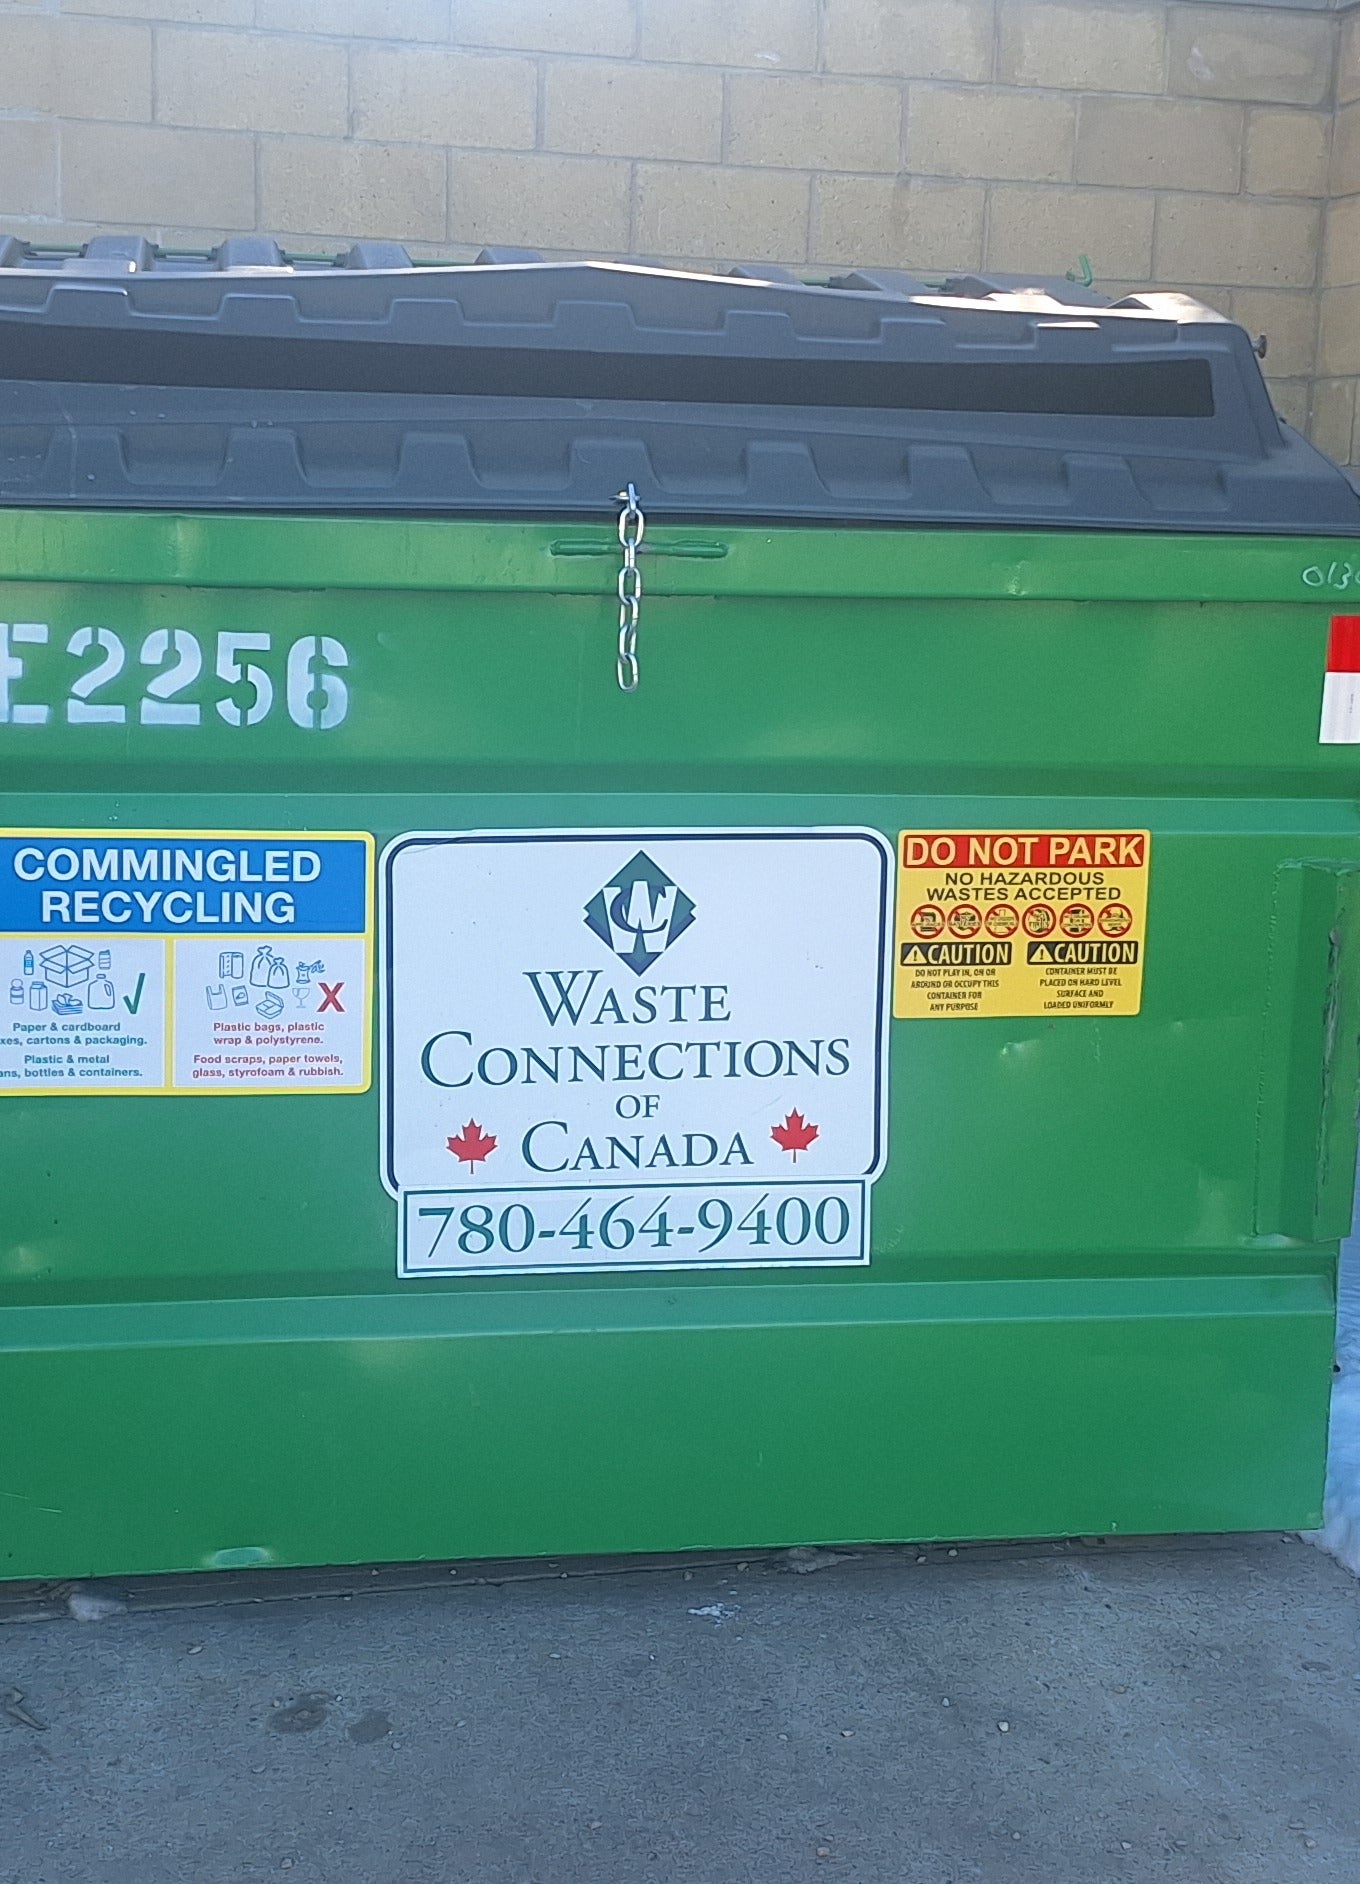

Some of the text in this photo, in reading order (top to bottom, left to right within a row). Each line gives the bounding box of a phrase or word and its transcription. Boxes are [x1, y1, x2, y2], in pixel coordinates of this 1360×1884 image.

[907, 836, 1143, 865] DO NOT PARK
[14, 848, 321, 882] COMMINGLED
[945, 872, 1104, 885] NO HAZARDOUS
[927, 887, 1121, 900] WASTES ACCEPTED
[42, 891, 295, 923] RECYCLING
[928, 944, 1009, 964] CAUTION
[1054, 943, 1135, 962] CAUTION
[915, 969, 925, 977] DO
[927, 969, 941, 977] NOT
[1109, 967, 1117, 975] BE
[1101, 978, 1121, 986] LEVEL
[946, 1003, 978, 1011] PURPOSE
[1044, 1001, 1071, 1009] LOADED
[13, 1022, 120, 1033] Paper & cardboard
[214, 1022, 325, 1033] Plastic bags, plastic
[26, 1036, 70, 1045] cartons
[74, 1036, 81, 1044] &
[85, 1036, 147, 1046] packaging.
[214, 1035, 323, 1046] wrap & polystyrene.
[24, 1055, 109, 1064] Plastic & metal
[194, 1054, 343, 1065] Food scraps, paper towels,
[25, 1068, 64, 1077] bottles
[68, 1068, 75, 1077] &
[79, 1068, 142, 1077] containers.
[193, 1067, 343, 1078] glass, styrofoam & rubbish.
[616, 1094, 660, 1119] OF
[419, 1193, 850, 1258] 780-464-9400
